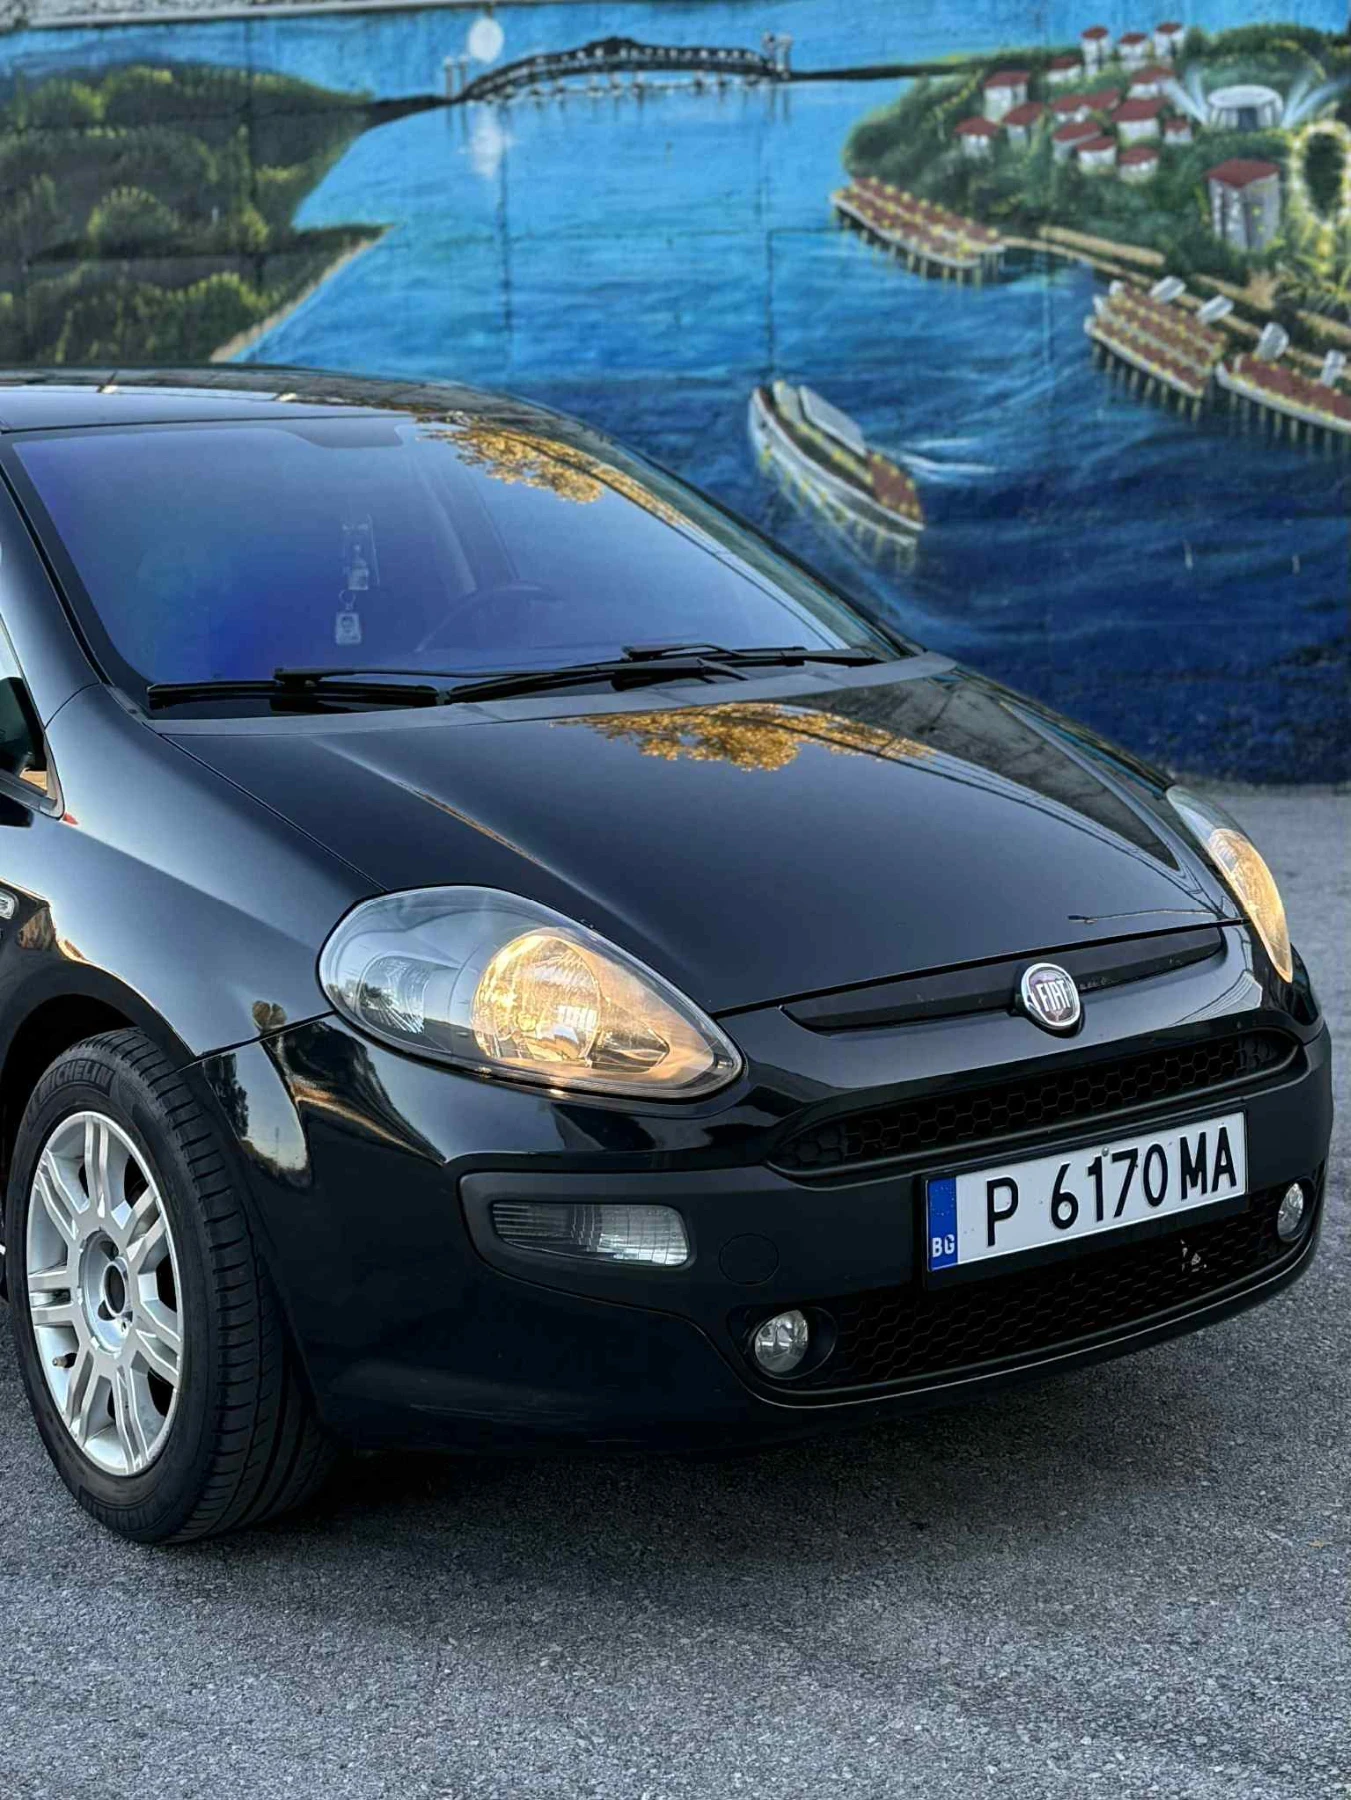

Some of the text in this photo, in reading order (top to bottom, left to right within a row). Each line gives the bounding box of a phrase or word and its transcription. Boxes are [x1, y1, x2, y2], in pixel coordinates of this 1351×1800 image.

[1035, 980, 1072, 1012] FIAT
[985, 1126, 1237, 1247] P 6170 MA
[932, 1234, 955, 1257] BG
